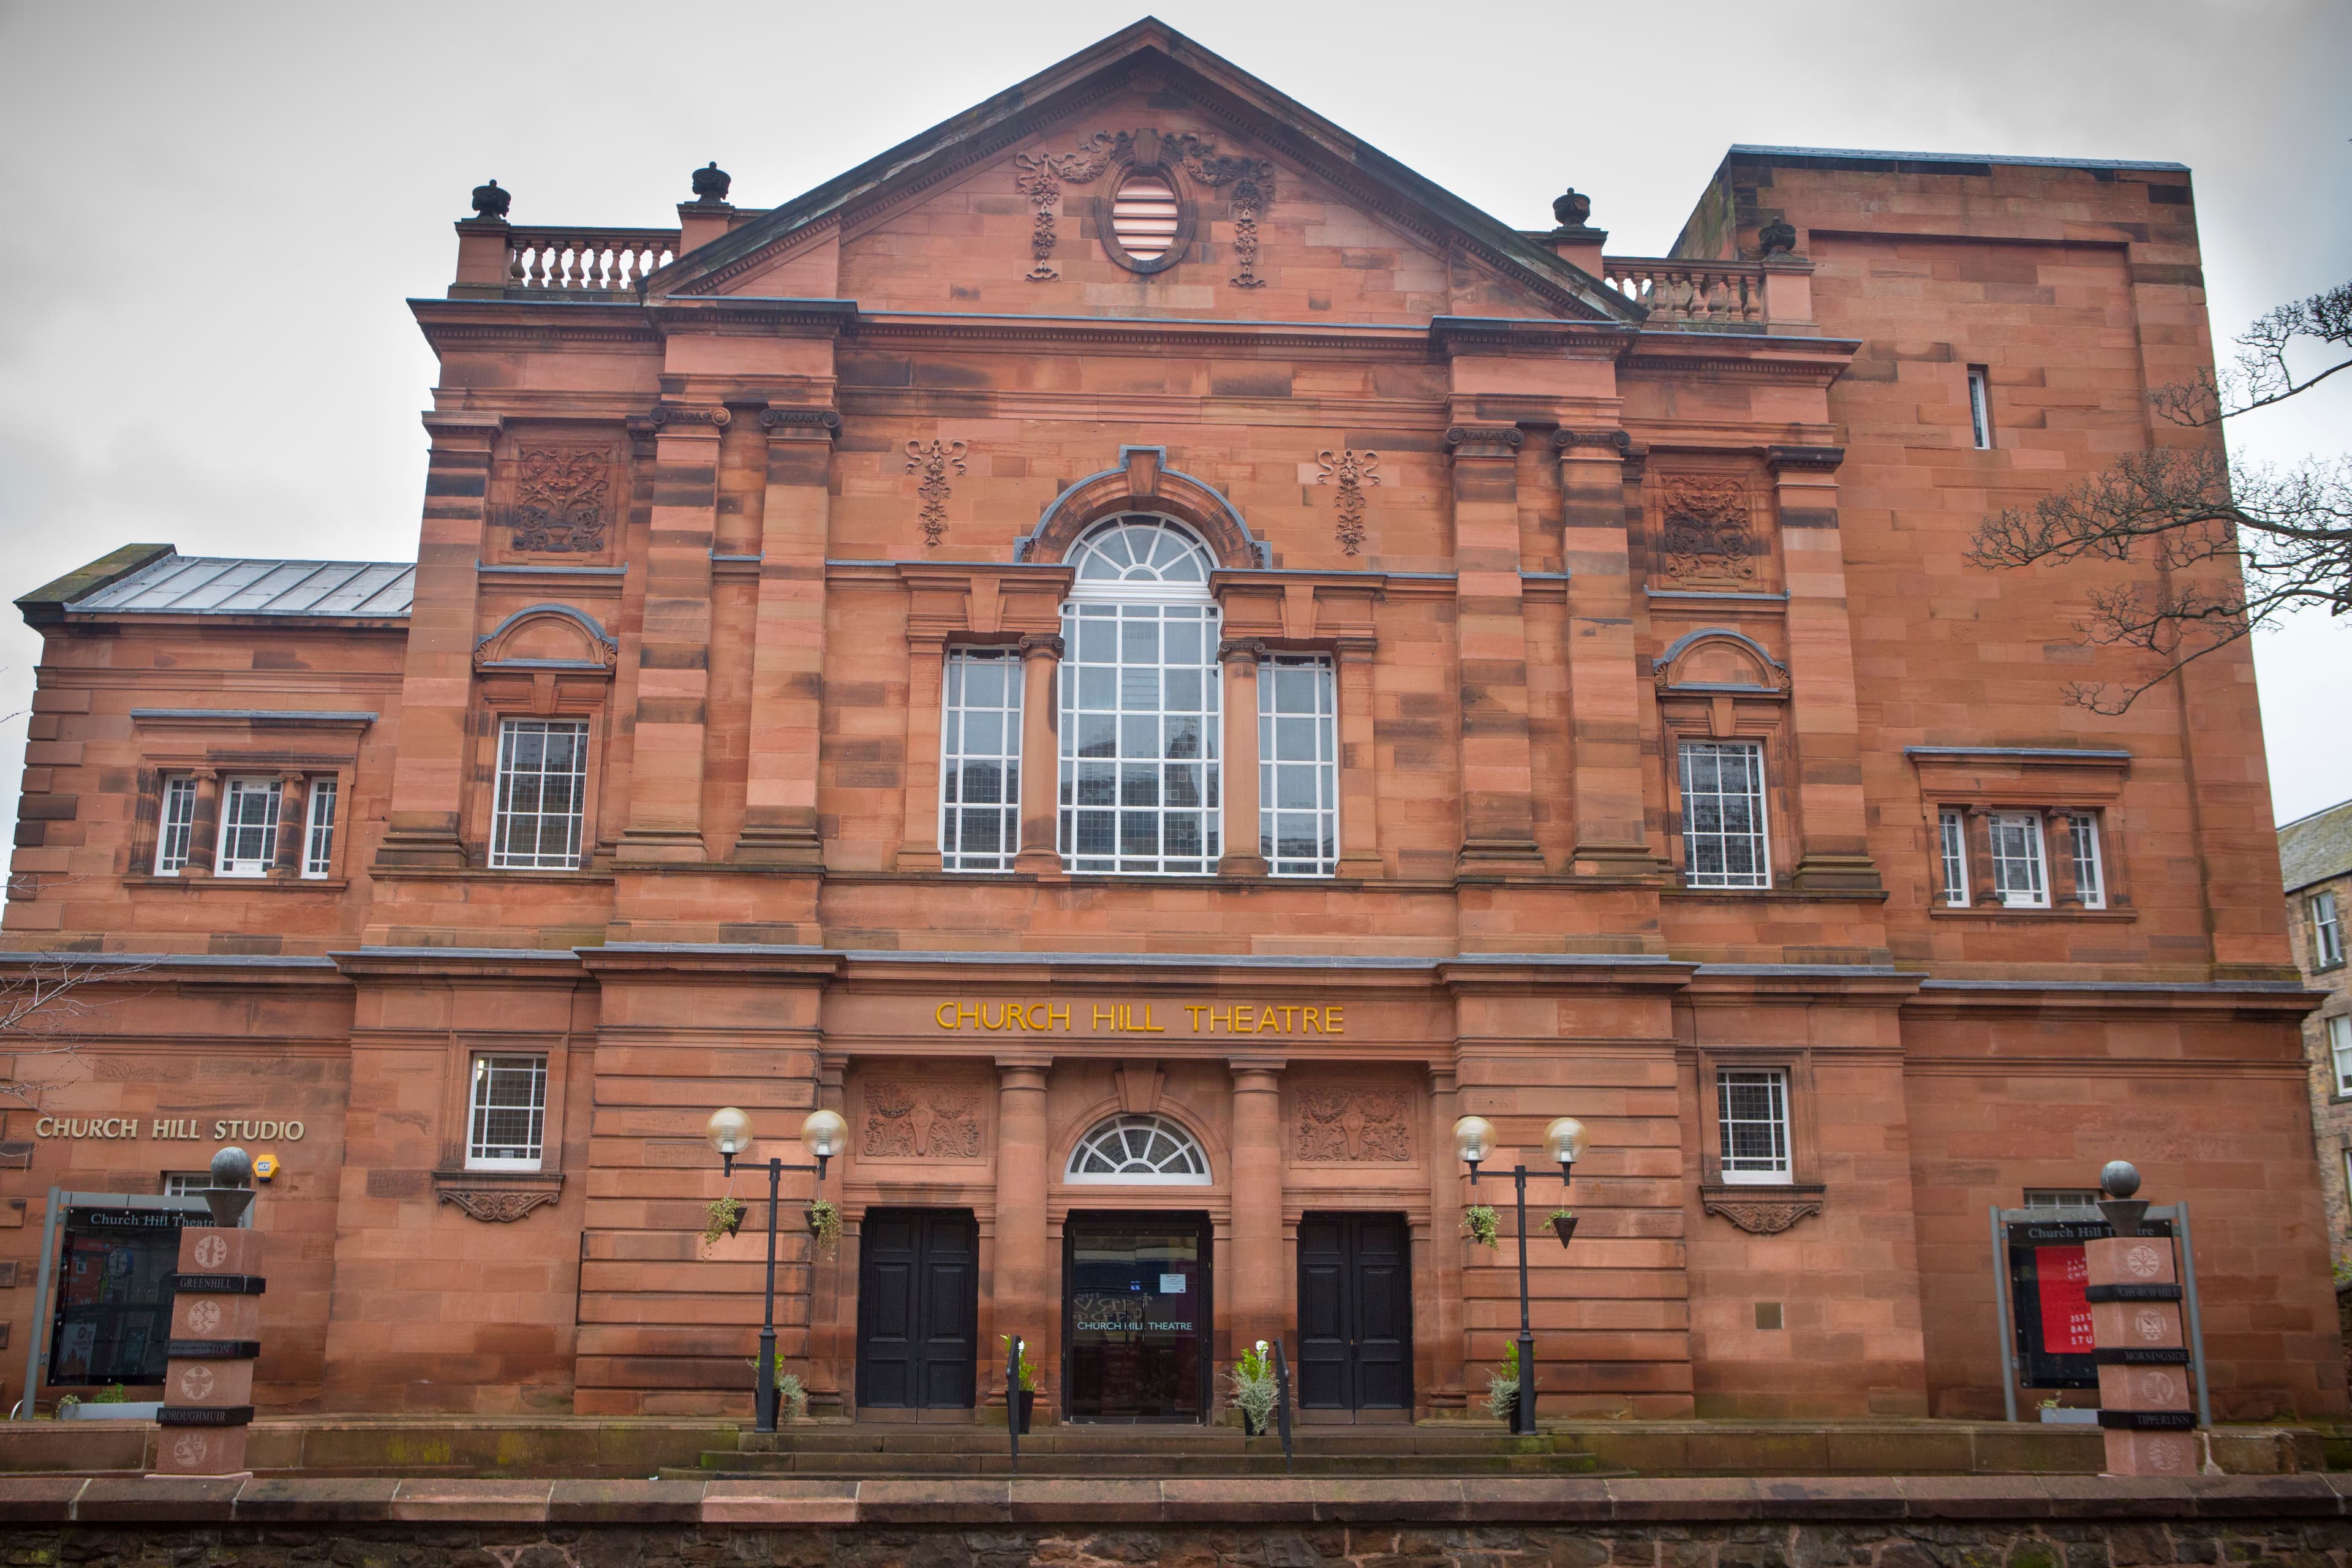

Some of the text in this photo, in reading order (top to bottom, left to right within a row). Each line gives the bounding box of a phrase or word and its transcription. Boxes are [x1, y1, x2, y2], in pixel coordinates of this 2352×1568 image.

[935, 1002, 1344, 1034] CHURCH HILL THEATRE
[35, 1117, 305, 1141] CHURCH HILL STUDIO
[91, 1213, 138, 1226] Church
[144, 1215, 167, 1226] Hill
[2028, 1226, 2155, 1238] Church Hill Ttre
[179, 1278, 232, 1288] GREENHILL
[2119, 1287, 2156, 1298] CHURCH
[1077, 1322, 1121, 1330] CHURCH
[1148, 1322, 1193, 1330] THEATRE
[2070, 1324, 2090, 1333] BAR
[2124, 1351, 2187, 1362] MORNINGSIDE
[159, 1411, 226, 1422] BOROUGHMUIR
[2136, 1415, 2192, 1425] TIPPERLINN
